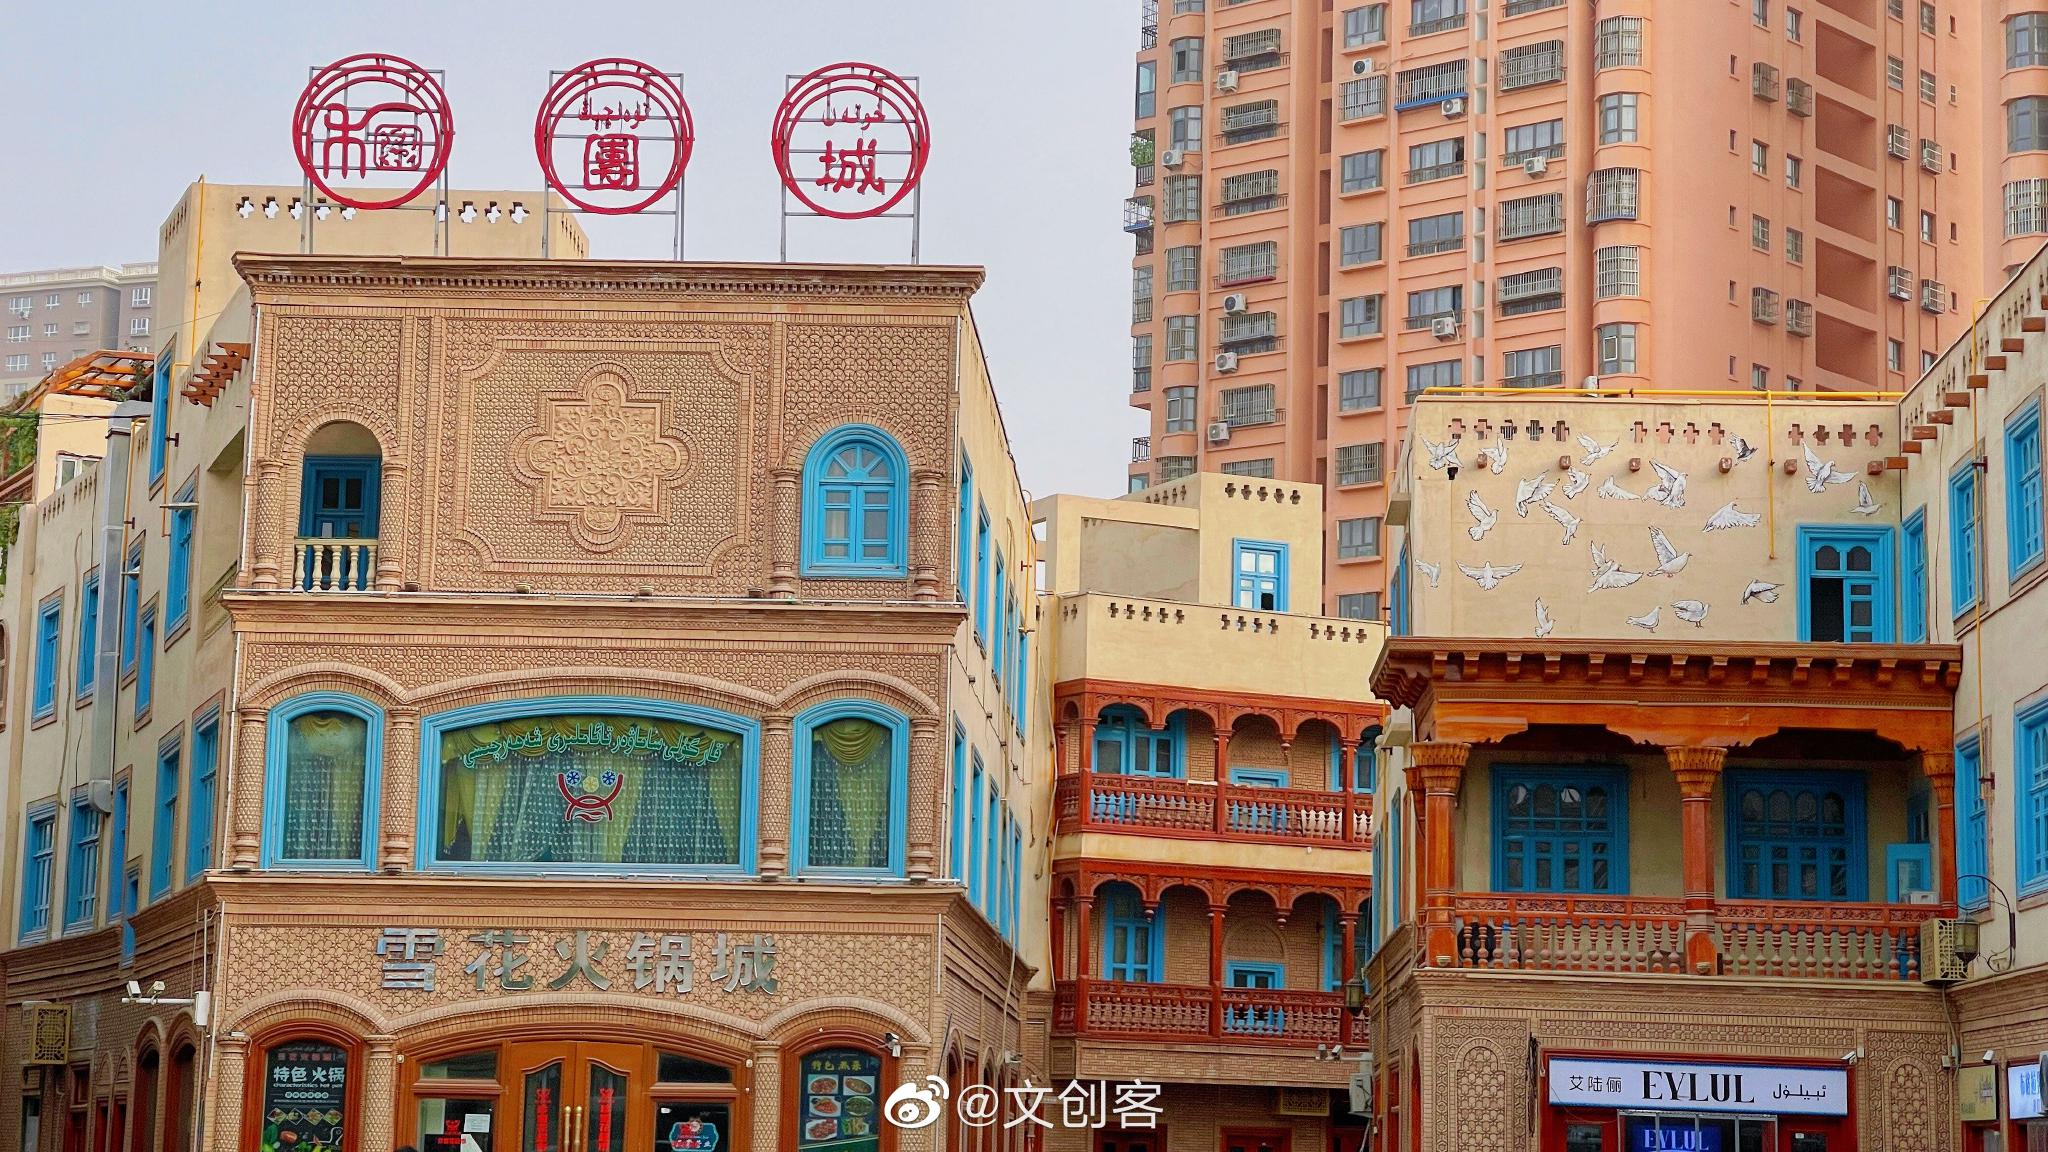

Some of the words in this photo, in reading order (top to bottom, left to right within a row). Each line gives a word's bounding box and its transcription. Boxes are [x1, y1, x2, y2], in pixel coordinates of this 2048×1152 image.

[376, 927, 778, 994] 雪花火锅城
[1569, 1074, 1623, 1094] 艾陆俪
[1641, 1070, 1755, 1104] EYLUL
[1644, 1128, 1710, 1151] EYLUL
